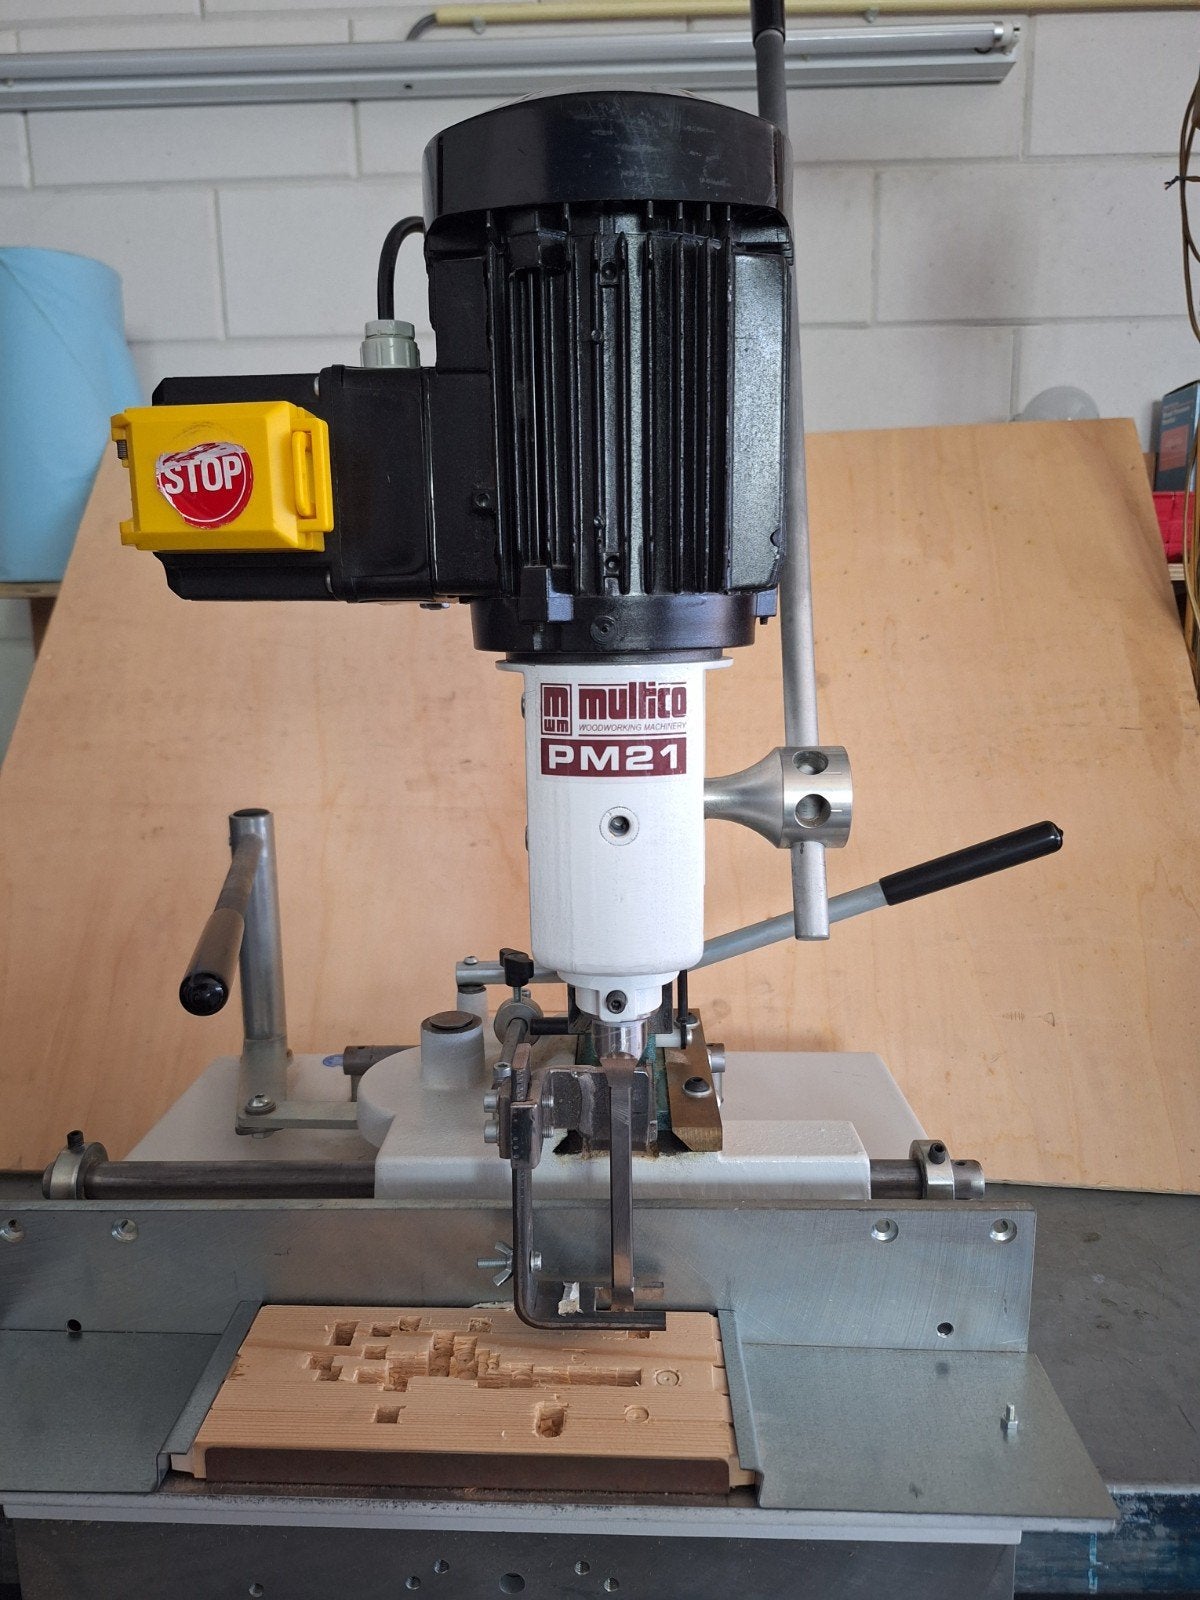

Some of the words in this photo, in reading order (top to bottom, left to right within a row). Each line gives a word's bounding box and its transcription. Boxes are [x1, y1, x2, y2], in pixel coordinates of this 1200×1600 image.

[165, 454, 242, 495] STOP
[579, 723, 642, 732] WOODWORKING
[644, 722, 686, 731] MACHINERY
[549, 744, 678, 771] PM21
